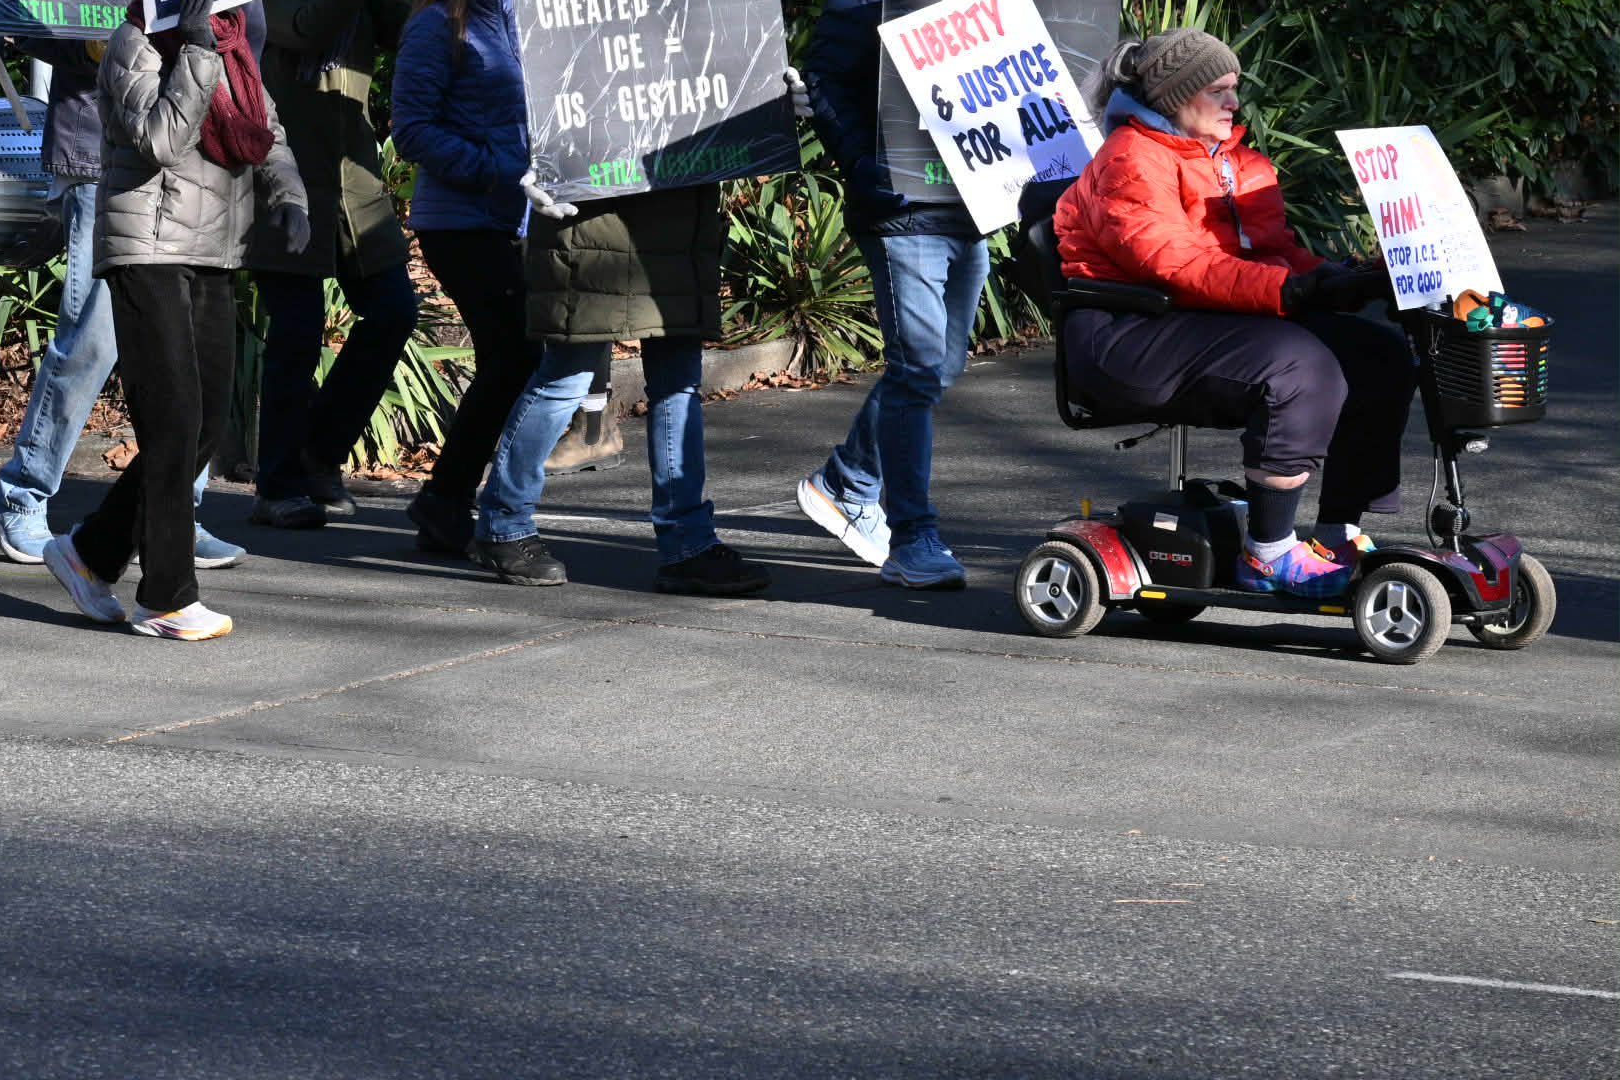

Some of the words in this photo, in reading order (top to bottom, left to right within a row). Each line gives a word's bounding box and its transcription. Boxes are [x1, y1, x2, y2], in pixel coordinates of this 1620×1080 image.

[20, 0, 68, 25] STILL
[602, 33, 645, 73] ICE
[664, 37, 683, 55] =
[554, 91, 587, 131] US
[617, 73, 729, 122] GESTAPO
[932, 84, 954, 122] &
[957, 43, 1058, 114] JUSTICE
[952, 121, 1012, 172] FOR
[1355, 144, 1398, 184] STOP
[588, 159, 643, 187] STILL
[1380, 192, 1425, 238] HIM!
[1388, 246, 1411, 268] STOP
[1396, 274, 1414, 295] FOR
[1417, 271, 1442, 293] GOOD
